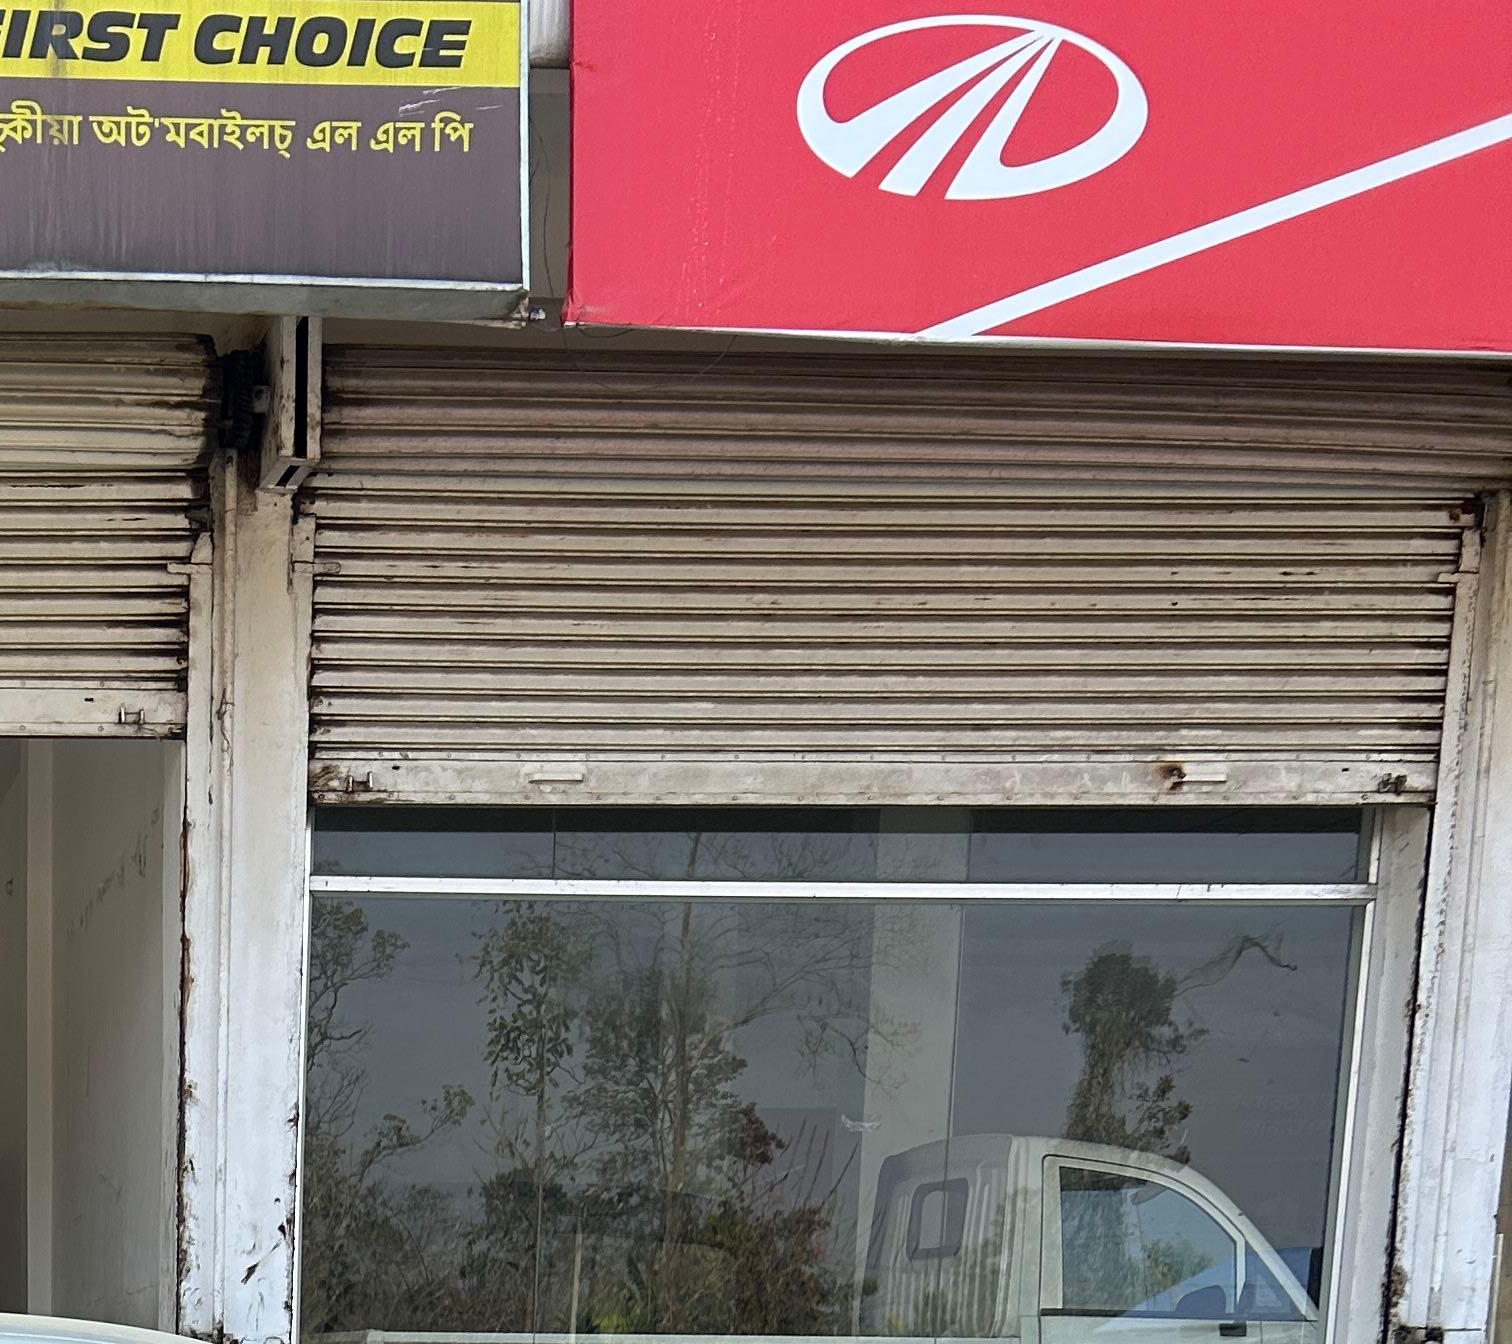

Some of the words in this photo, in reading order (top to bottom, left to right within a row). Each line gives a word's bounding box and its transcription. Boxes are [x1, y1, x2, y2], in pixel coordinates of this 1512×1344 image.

[193, 14, 472, 69] CHOICE
[305, 120, 363, 153] এল
[369, 121, 426, 154] এল
[431, 110, 475, 153] পি
